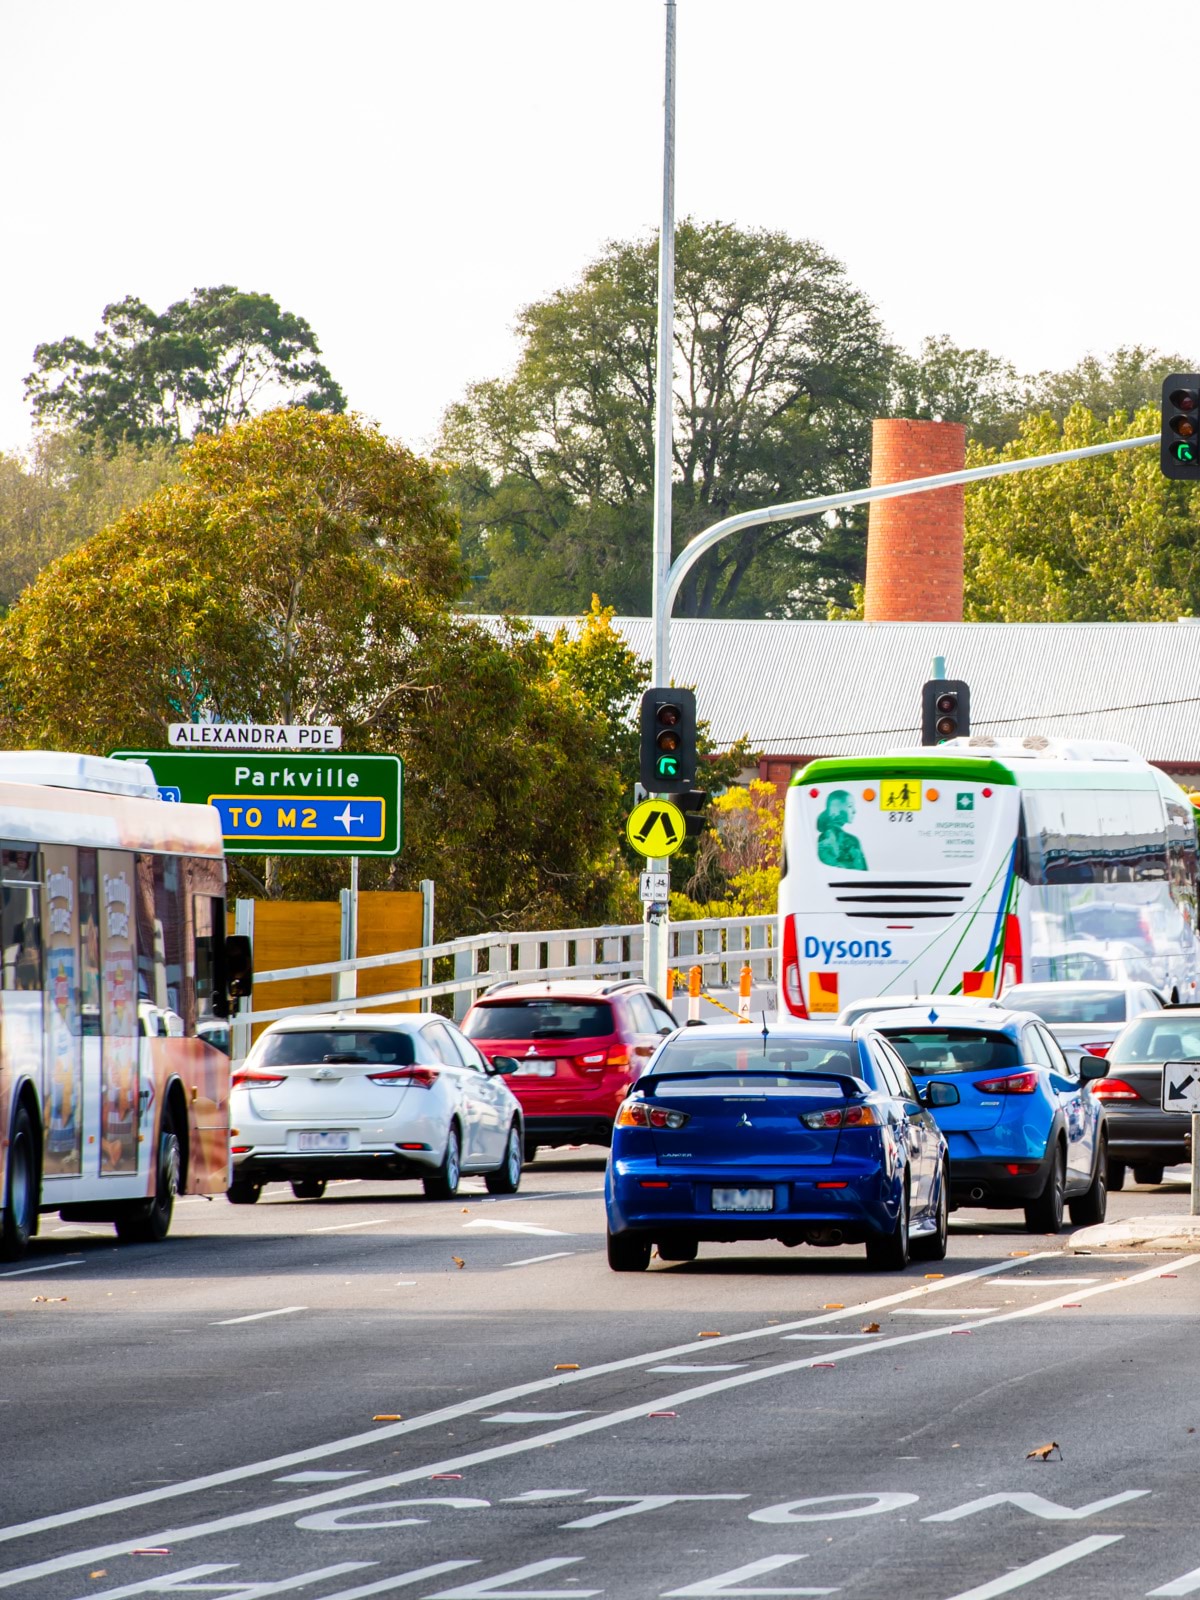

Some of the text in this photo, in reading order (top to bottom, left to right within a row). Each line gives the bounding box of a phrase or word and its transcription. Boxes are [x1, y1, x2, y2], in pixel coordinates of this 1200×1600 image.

[176, 727, 335, 744] ALEXANDRA PDE
[235, 766, 360, 787] Parkville
[228, 807, 318, 828] TO M2
[888, 811, 914, 823] 878
[804, 935, 892, 965] Dysons
